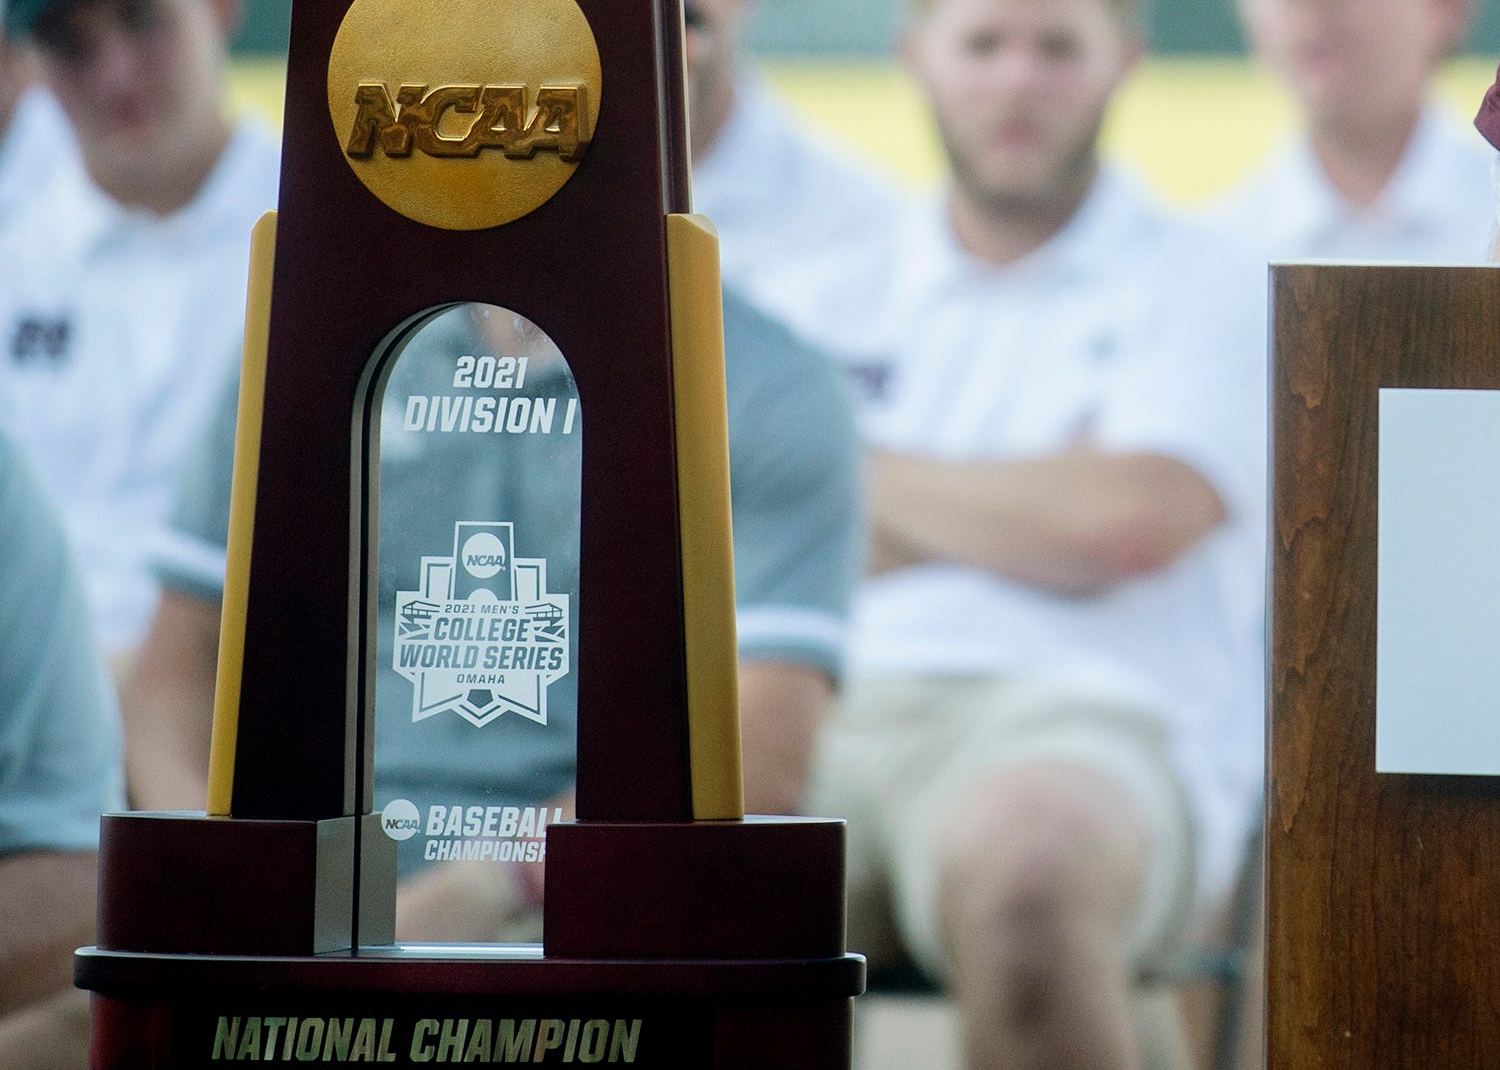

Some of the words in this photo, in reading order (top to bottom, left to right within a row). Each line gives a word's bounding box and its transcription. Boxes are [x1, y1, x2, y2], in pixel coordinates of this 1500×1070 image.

[347, 82, 590, 161] NCAA
[453, 356, 529, 389] 2021
[404, 396, 557, 434] DIVISION
[563, 398, 577, 435] I
[467, 555, 505, 567] NCAA
[445, 604, 476, 614] 2021
[481, 605, 519, 615] MEN'S
[434, 617, 531, 642] COLLEGE
[400, 644, 480, 669] WORLD
[483, 646, 564, 670] SERIES
[457, 673, 505, 684] OMAHA
[385, 819, 420, 830] NCAA
[424, 840, 546, 863] CHAMPIONS
[212, 1016, 396, 1062] NATIONAL
[409, 1018, 642, 1063] CHAMPION
